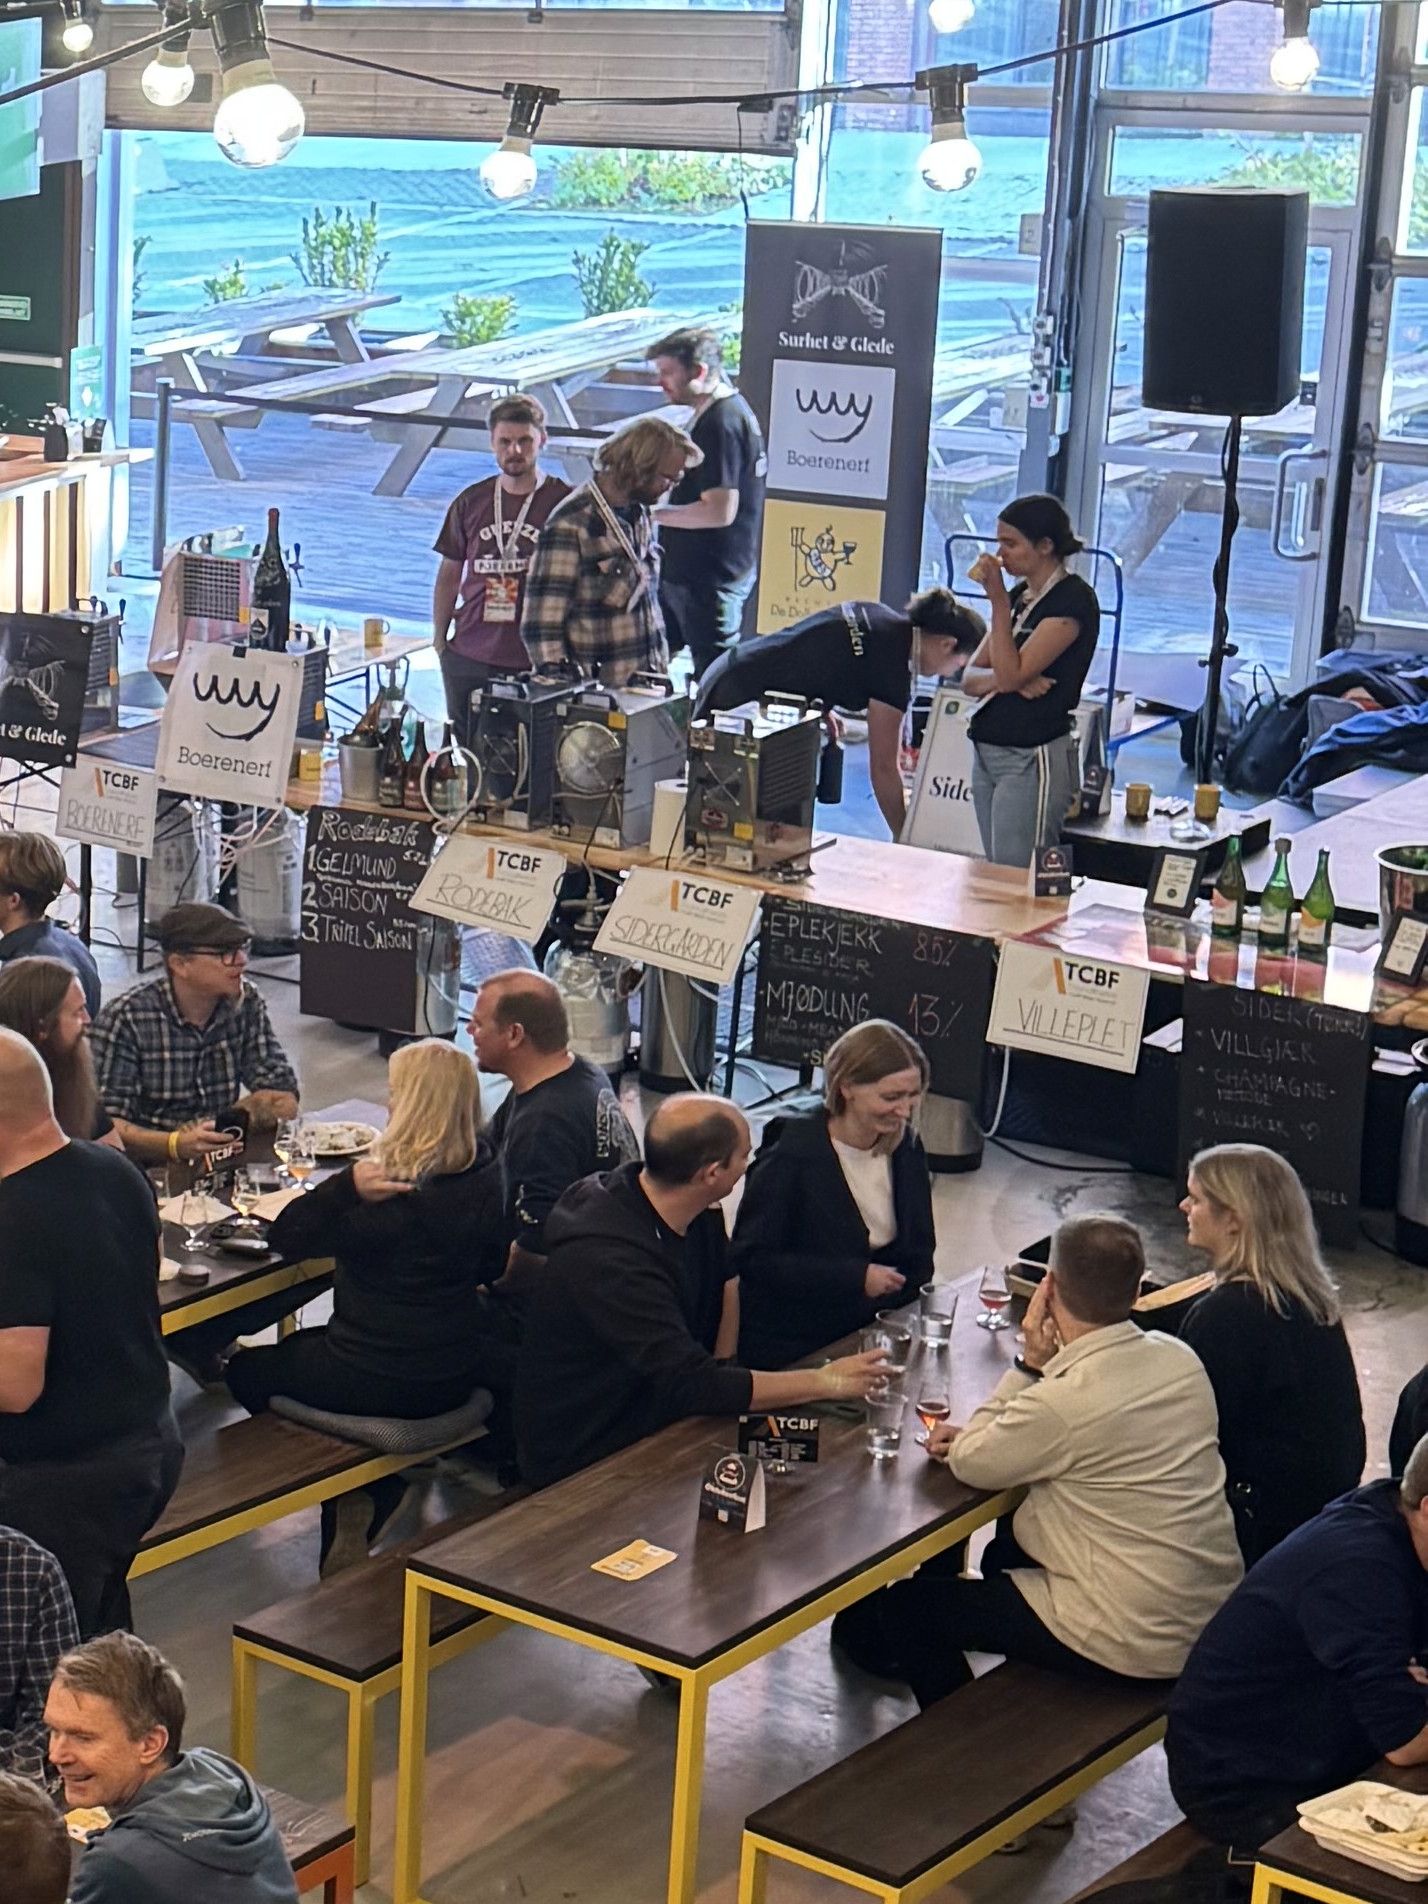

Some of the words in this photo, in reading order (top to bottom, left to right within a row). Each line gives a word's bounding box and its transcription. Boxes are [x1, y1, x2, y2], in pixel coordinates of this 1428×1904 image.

[850, 336, 894, 354] Glede
[787, 449, 870, 473] Boerenerf
[177, 745, 272, 779] Boerenerf
[102, 770, 140, 792] TCBF
[496, 850, 543, 874] TCBF
[318, 883, 388, 916] SAISON
[681, 880, 734, 910] TCBF
[770, 911, 884, 956] EPLEKJEKK
[1065, 961, 1120, 989] TCBF
[1018, 998, 1135, 1049] VILLEPLET
[777, 1417, 819, 1431] TCBF
